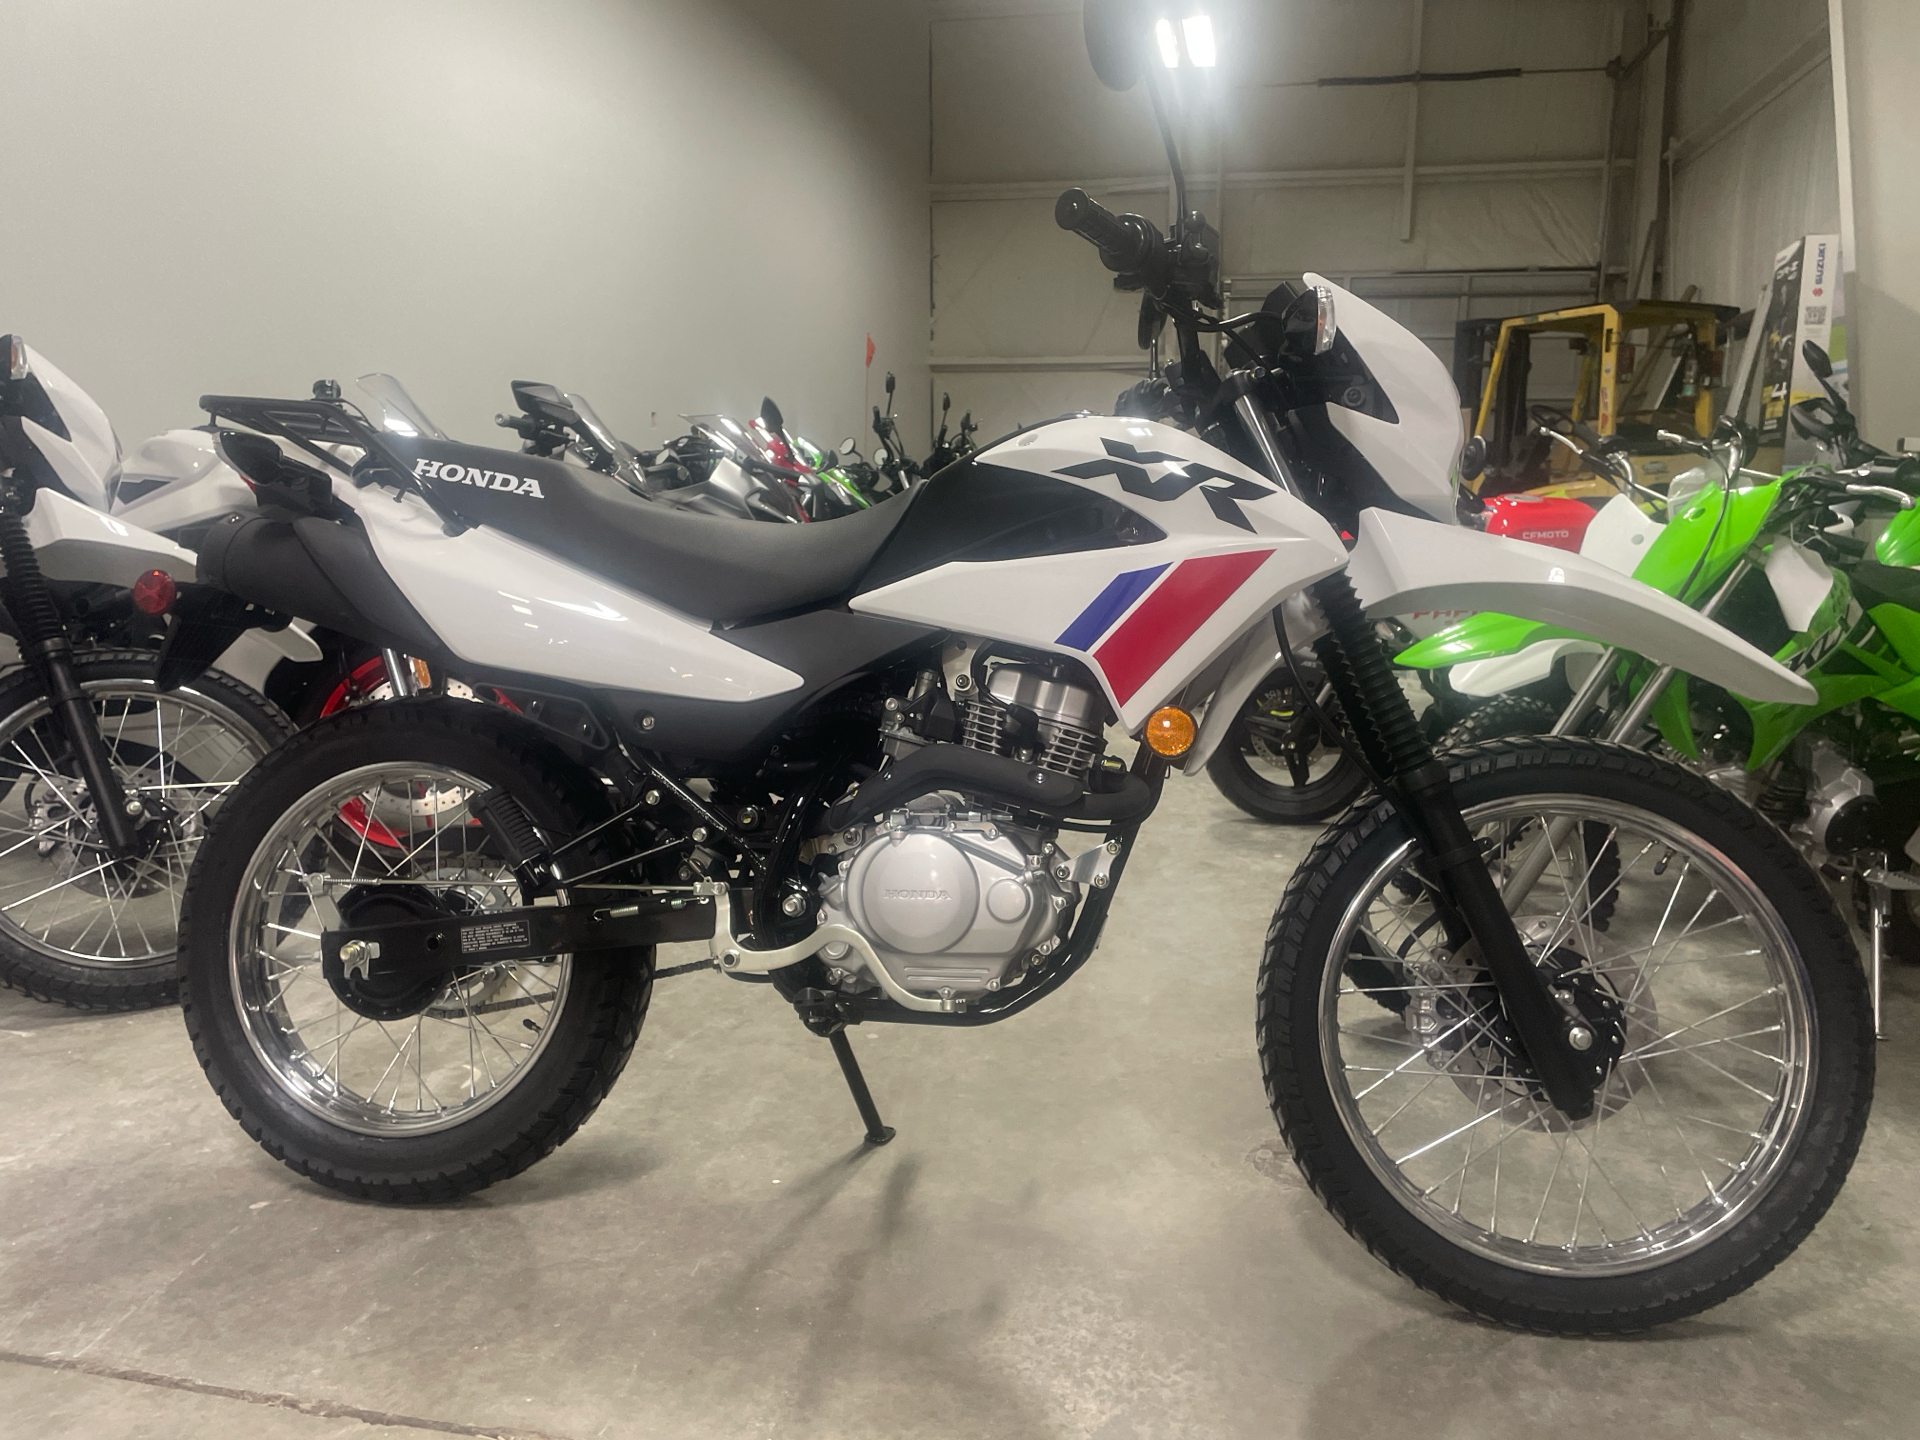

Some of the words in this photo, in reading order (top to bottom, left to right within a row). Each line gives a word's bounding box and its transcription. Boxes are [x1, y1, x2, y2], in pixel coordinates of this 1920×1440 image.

[1814, 243, 1826, 285] SUZUKI
[413, 458, 545, 499] HONDA
[1522, 530, 1569, 540] CFMOTO
[883, 889, 953, 901] HONDA
